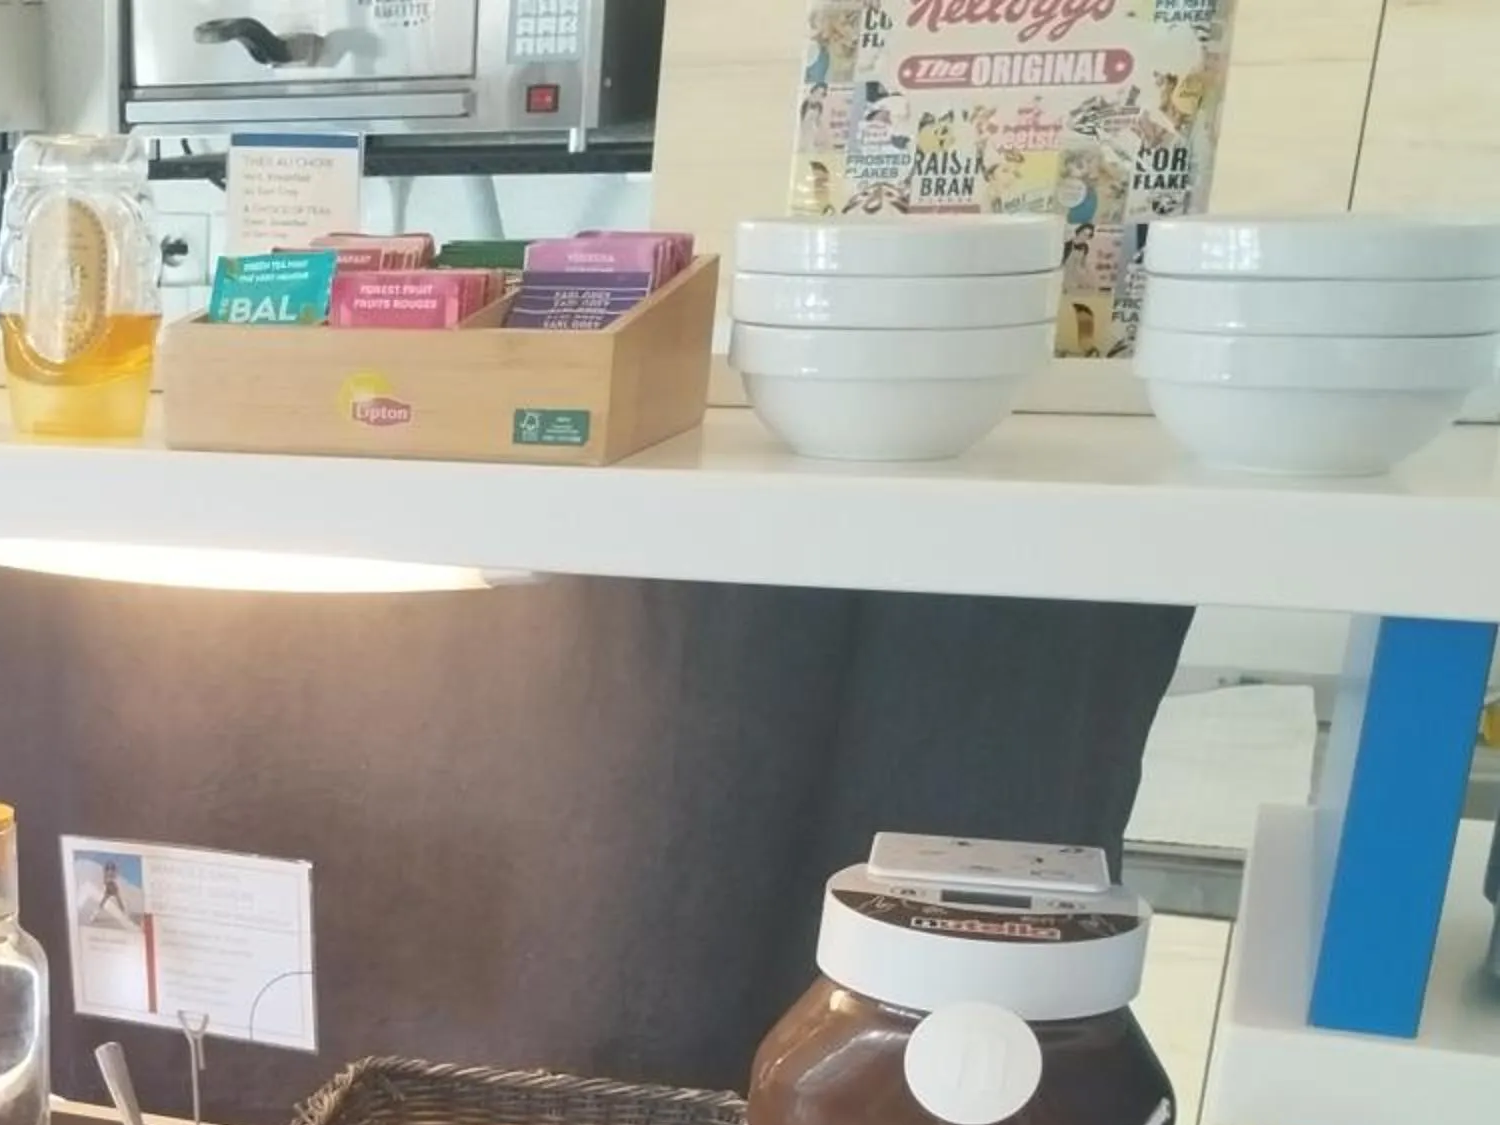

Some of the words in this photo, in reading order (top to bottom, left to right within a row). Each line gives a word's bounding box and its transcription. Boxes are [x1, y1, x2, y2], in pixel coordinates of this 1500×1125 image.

[971, 51, 1109, 86] ORIGINAL
[1136, 147, 1190, 173] COR
[920, 177, 975, 197] BRAN
[359, 284, 401, 295] FOREST
[402, 284, 433, 295] FRUIT
[353, 298, 391, 310] FRUITS
[392, 299, 438, 310] ROUGES
[355, 403, 409, 422] Lipton
[912, 916, 1061, 940] nutella
